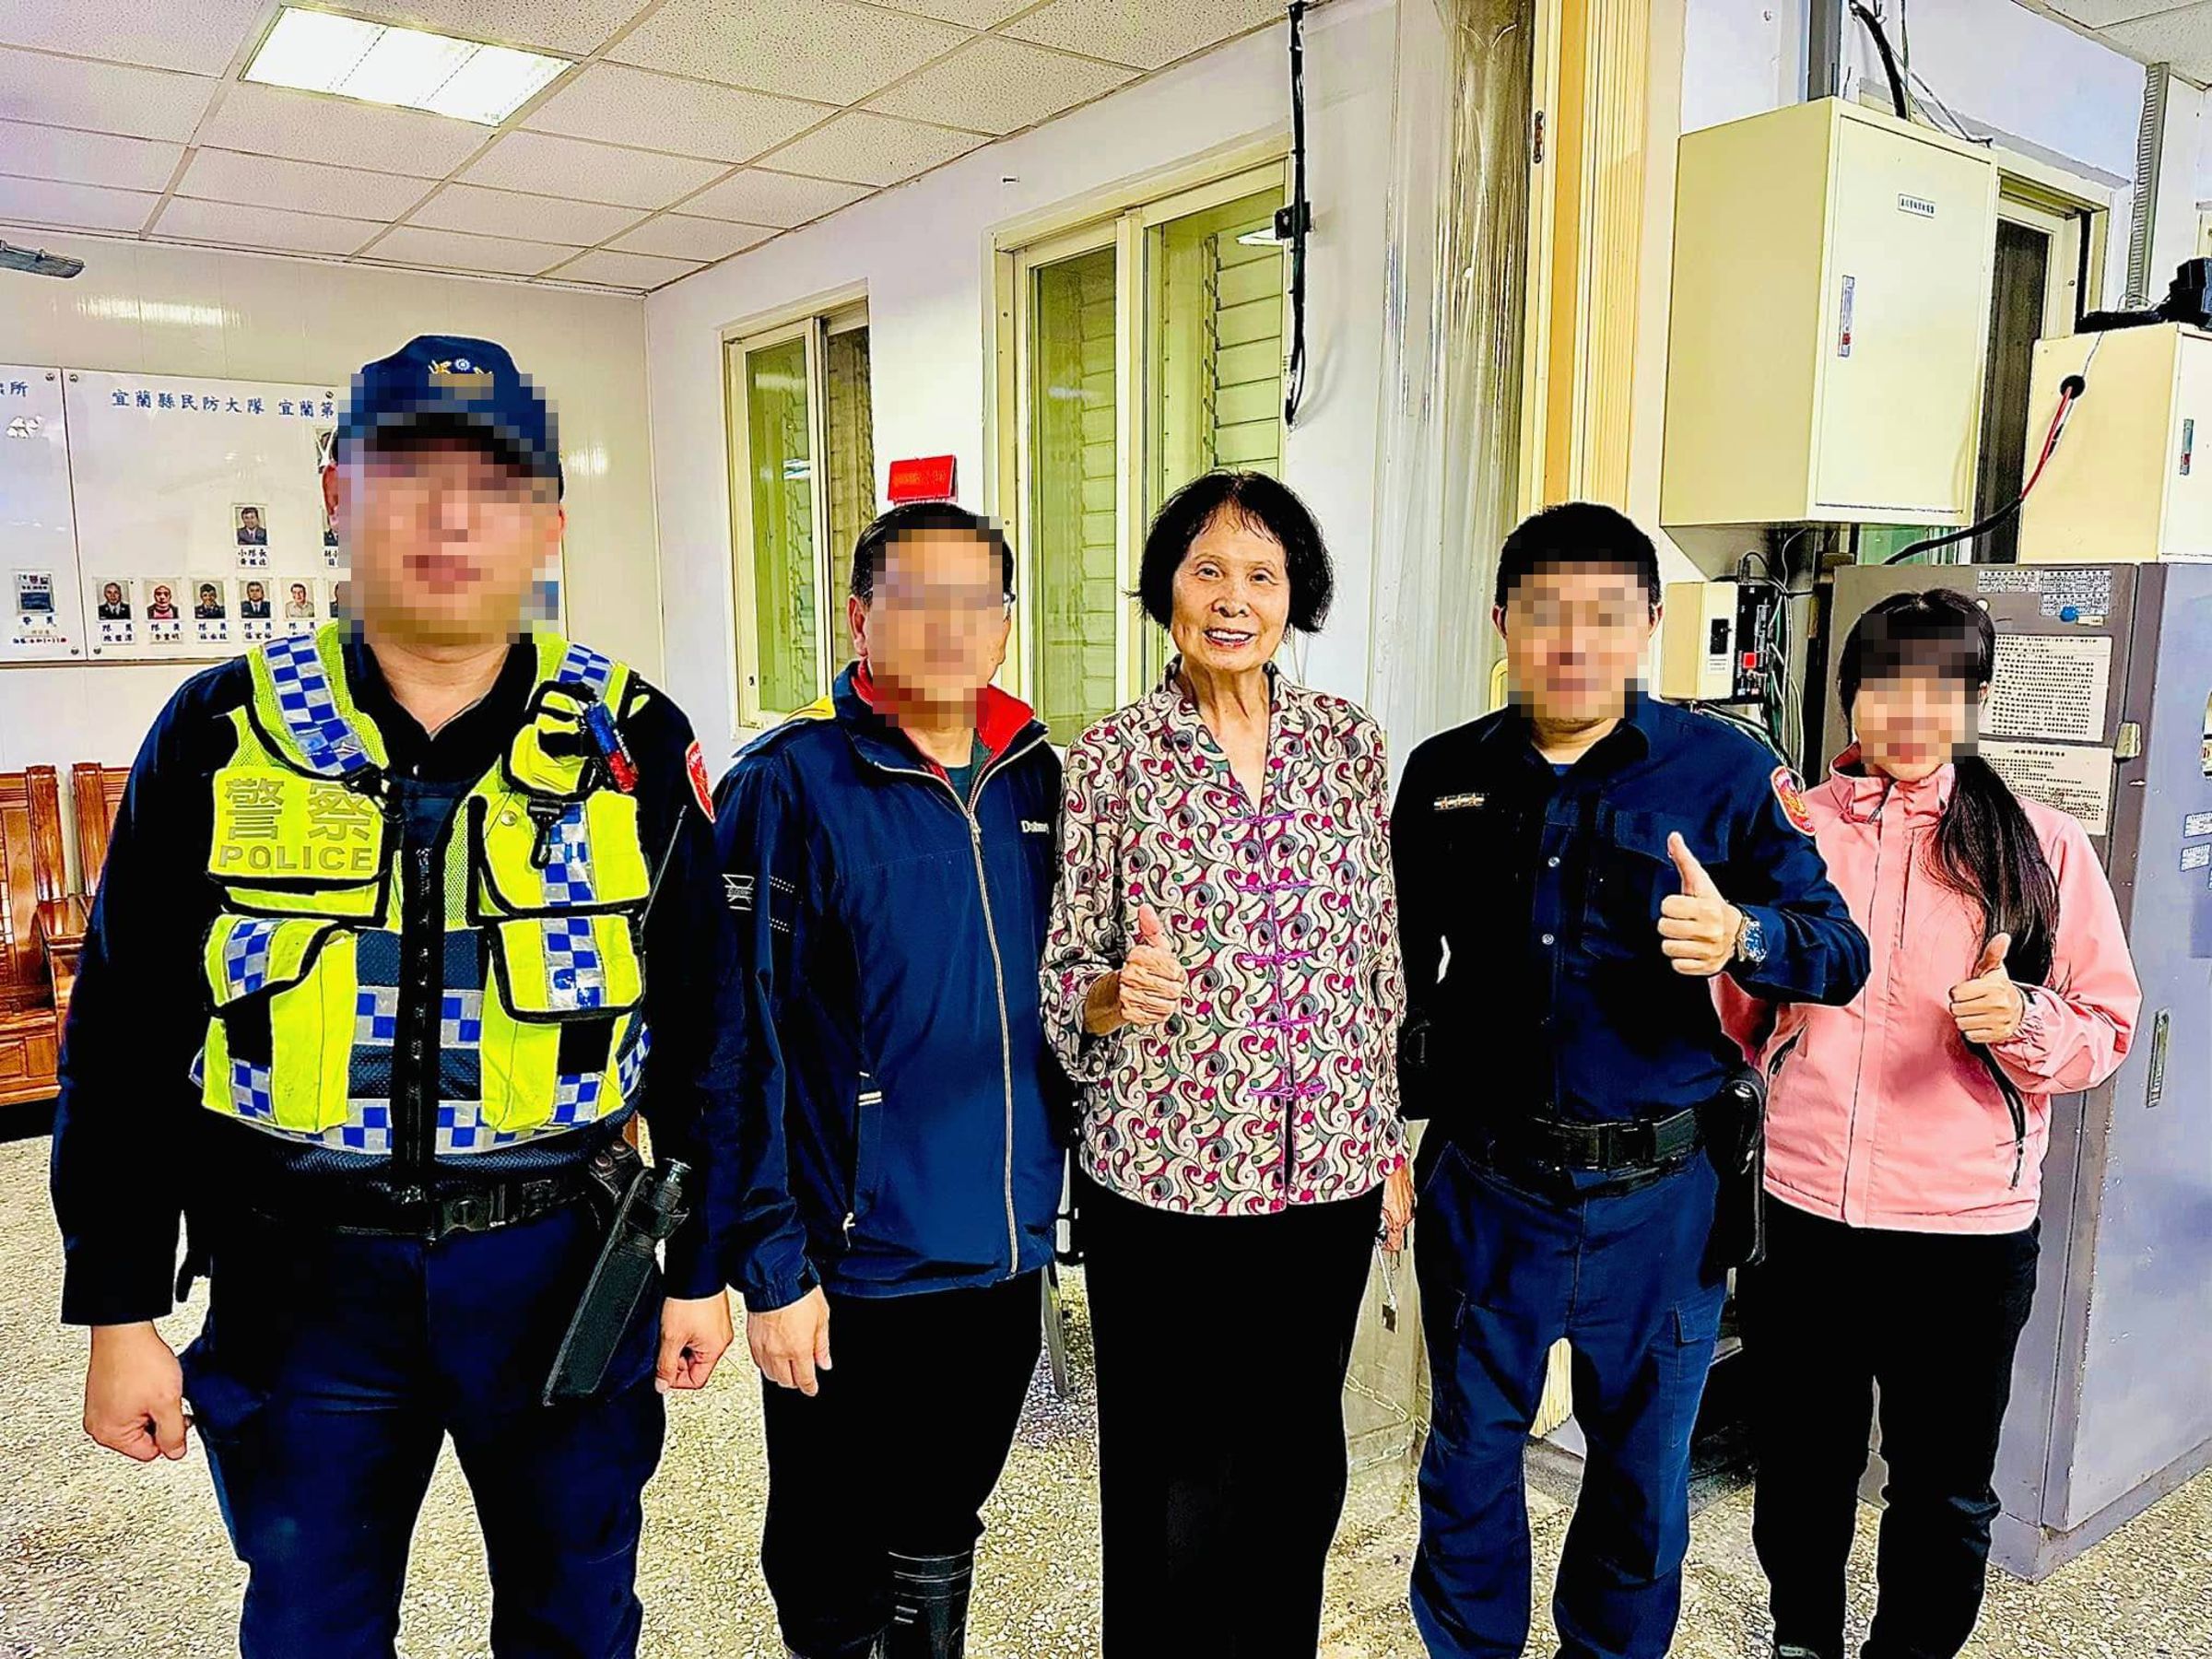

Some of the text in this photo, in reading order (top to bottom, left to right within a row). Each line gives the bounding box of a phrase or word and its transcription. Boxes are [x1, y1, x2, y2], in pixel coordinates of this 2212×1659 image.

[112, 389, 265, 415] 宜蘭縣民防大隊
[225, 778, 374, 841] 警察
[218, 844, 372, 871] POLICE
